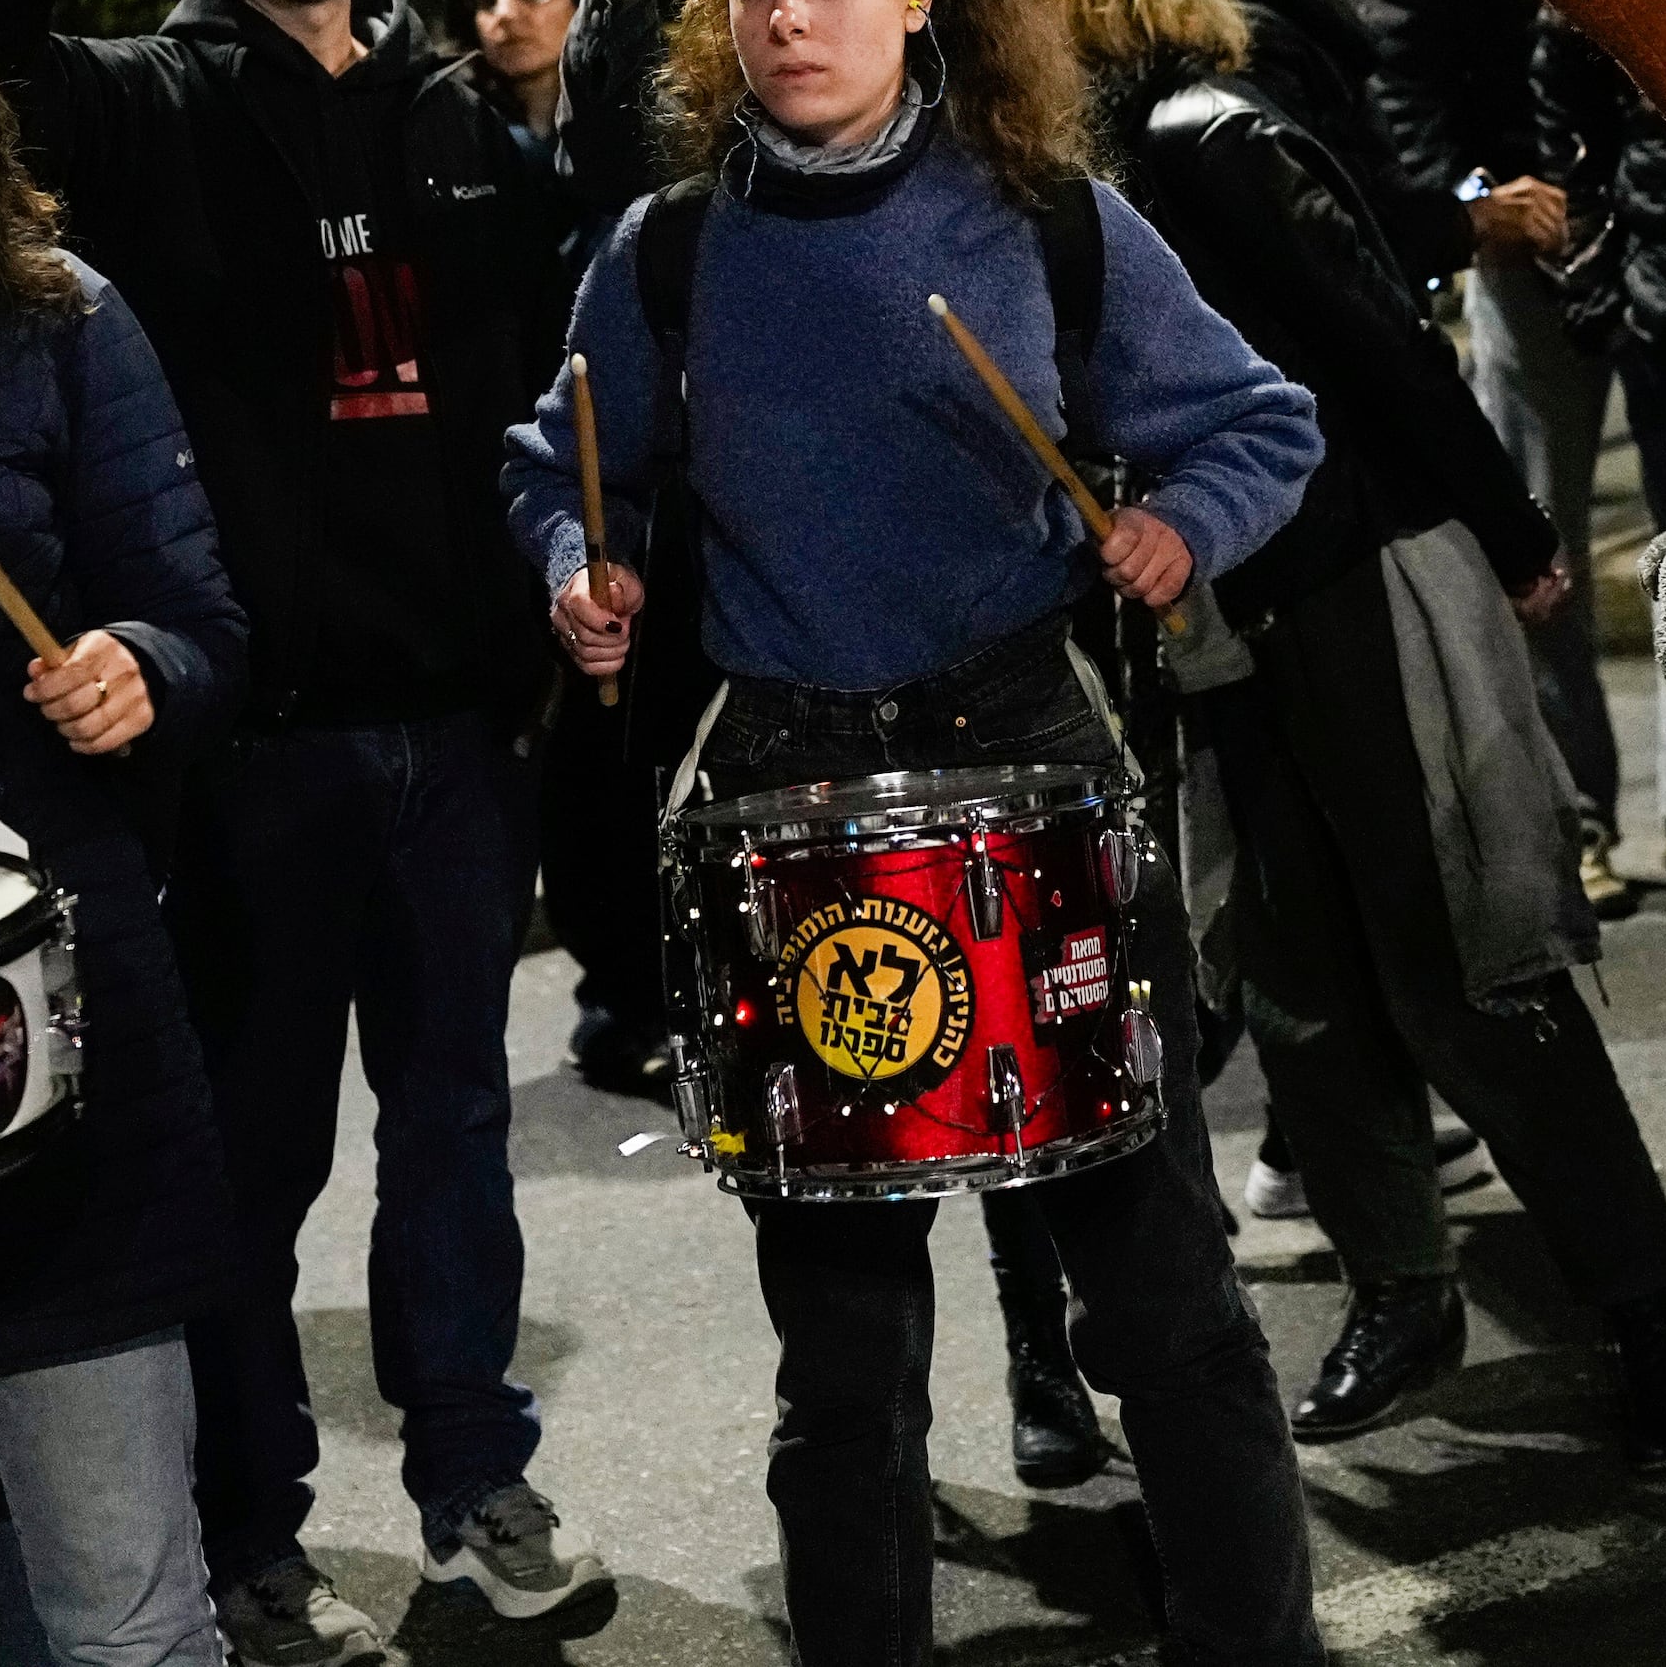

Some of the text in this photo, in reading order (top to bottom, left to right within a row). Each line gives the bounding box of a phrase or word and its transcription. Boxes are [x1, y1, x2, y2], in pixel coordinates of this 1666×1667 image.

[1071, 936, 1101, 960] מחאת
[827, 941, 920, 1003] לא
[820, 1020, 907, 1063] ספרנו
